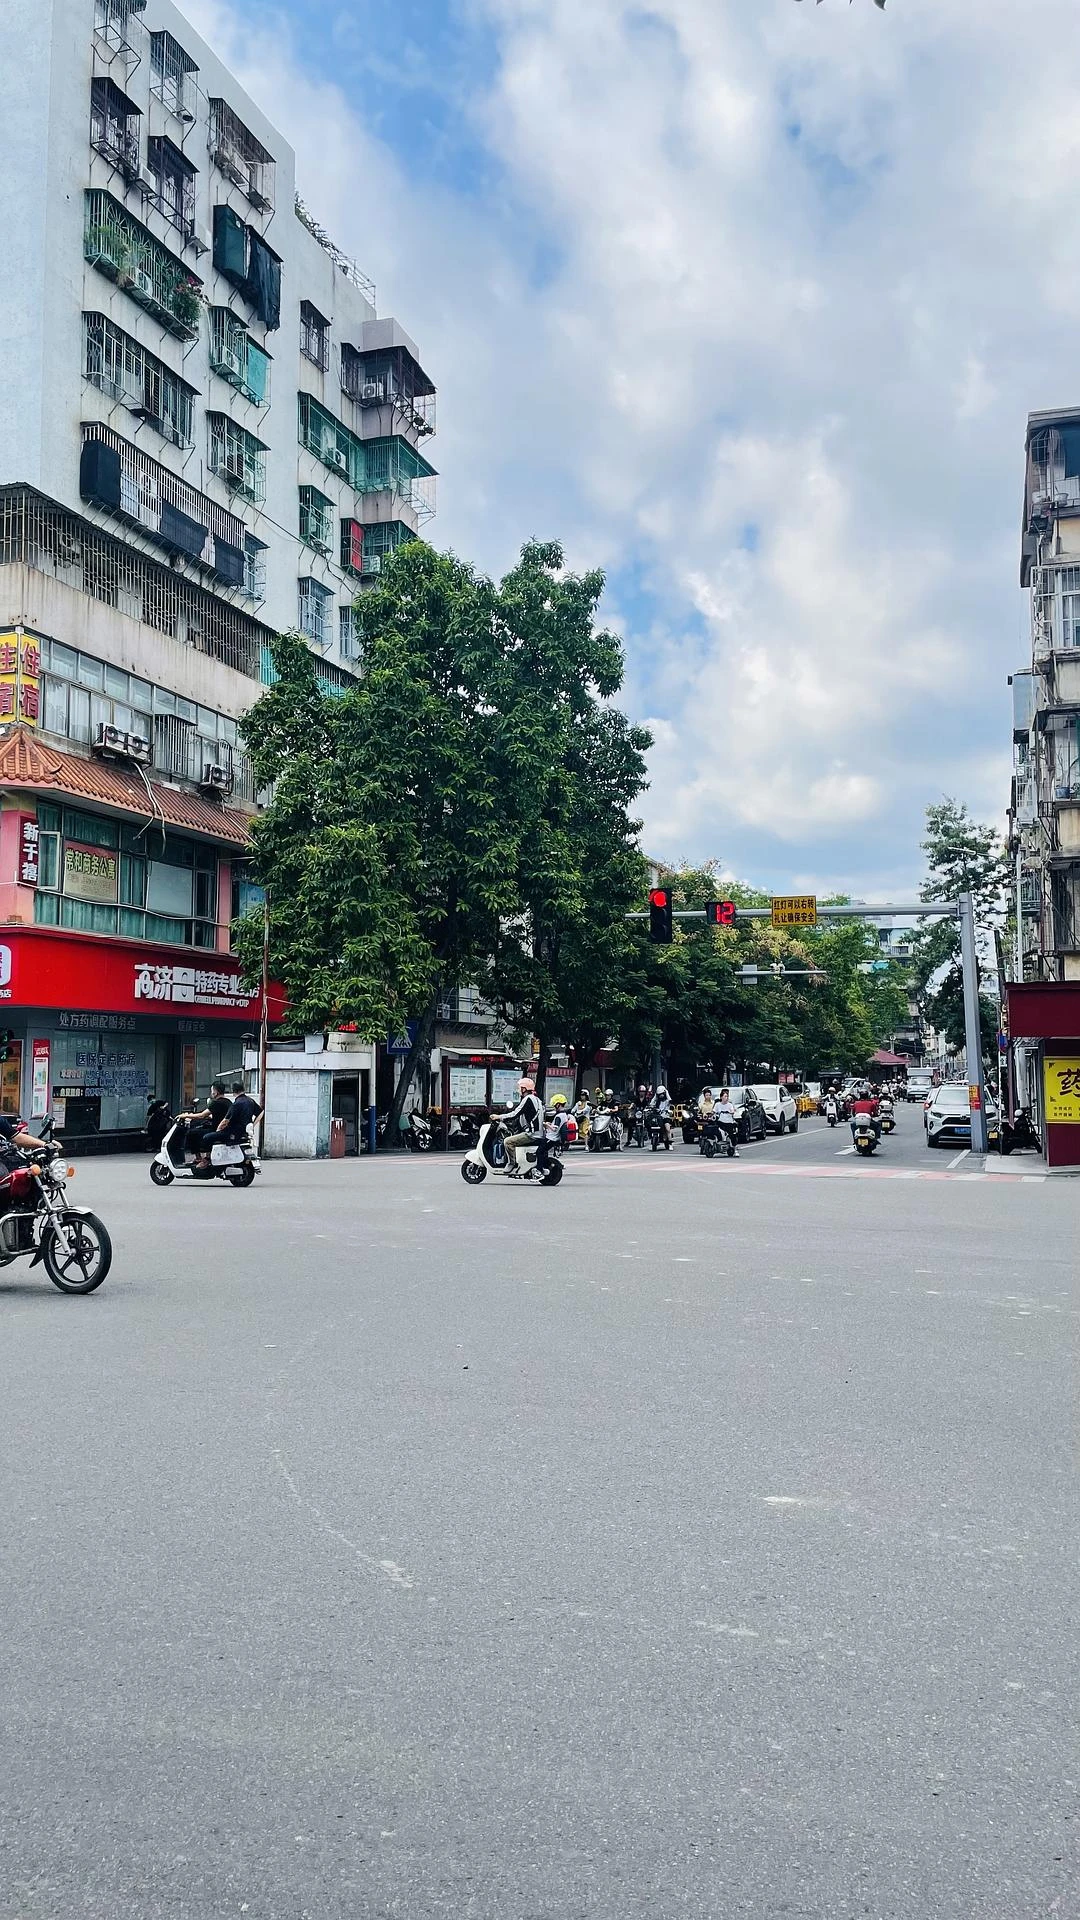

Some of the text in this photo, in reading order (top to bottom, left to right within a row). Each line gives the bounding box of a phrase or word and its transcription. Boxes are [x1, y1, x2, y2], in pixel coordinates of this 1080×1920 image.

[21, 641, 40, 719] 住宿
[716, 901, 735, 924] 12
[774, 898, 814, 910] 红灯可以右转
[774, 912, 814, 923] 礼让确保安全
[134, 963, 173, 1000] 高济
[59, 1011, 136, 1030] 处方药调配服务点
